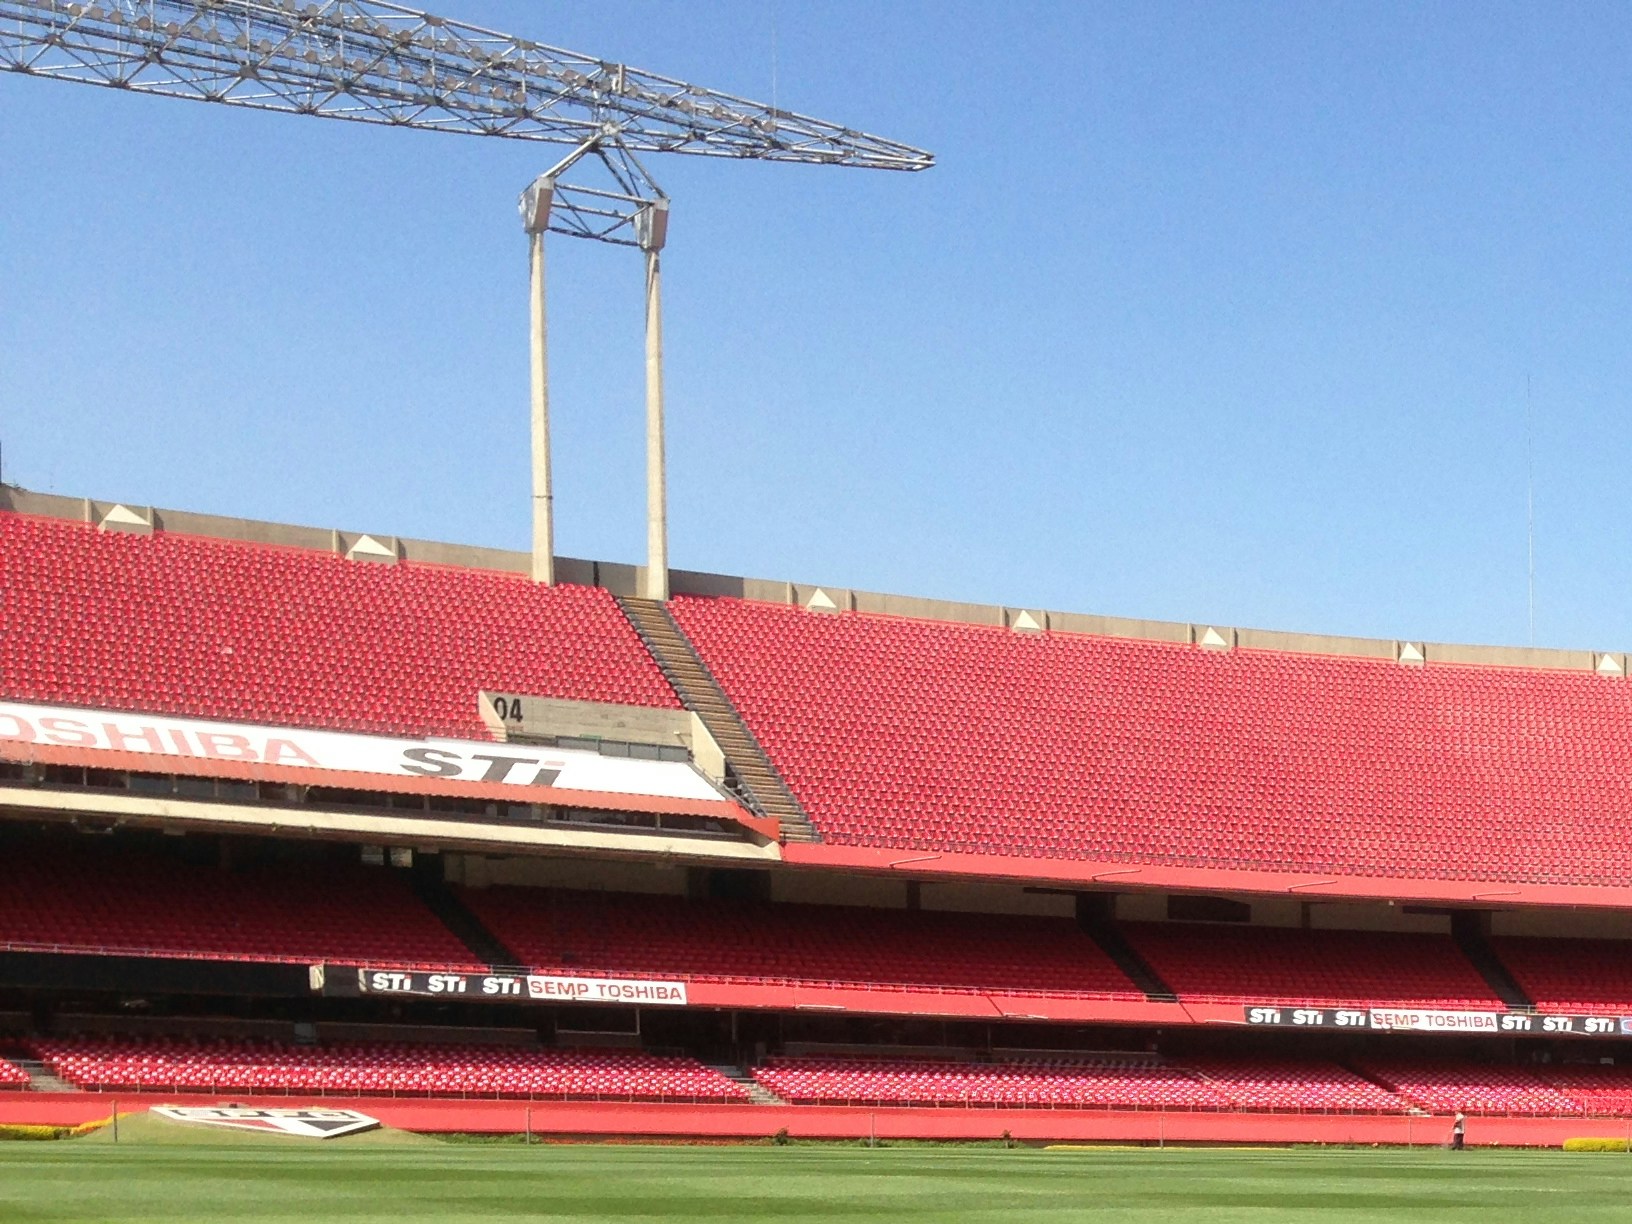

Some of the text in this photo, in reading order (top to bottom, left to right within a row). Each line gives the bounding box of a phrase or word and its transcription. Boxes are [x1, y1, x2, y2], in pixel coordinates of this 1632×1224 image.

[493, 697, 523, 722] 04
[530, 980, 682, 1001] SEMP TOSHIBA
[1373, 1013, 1495, 1028] SEMP TOSHIBA
